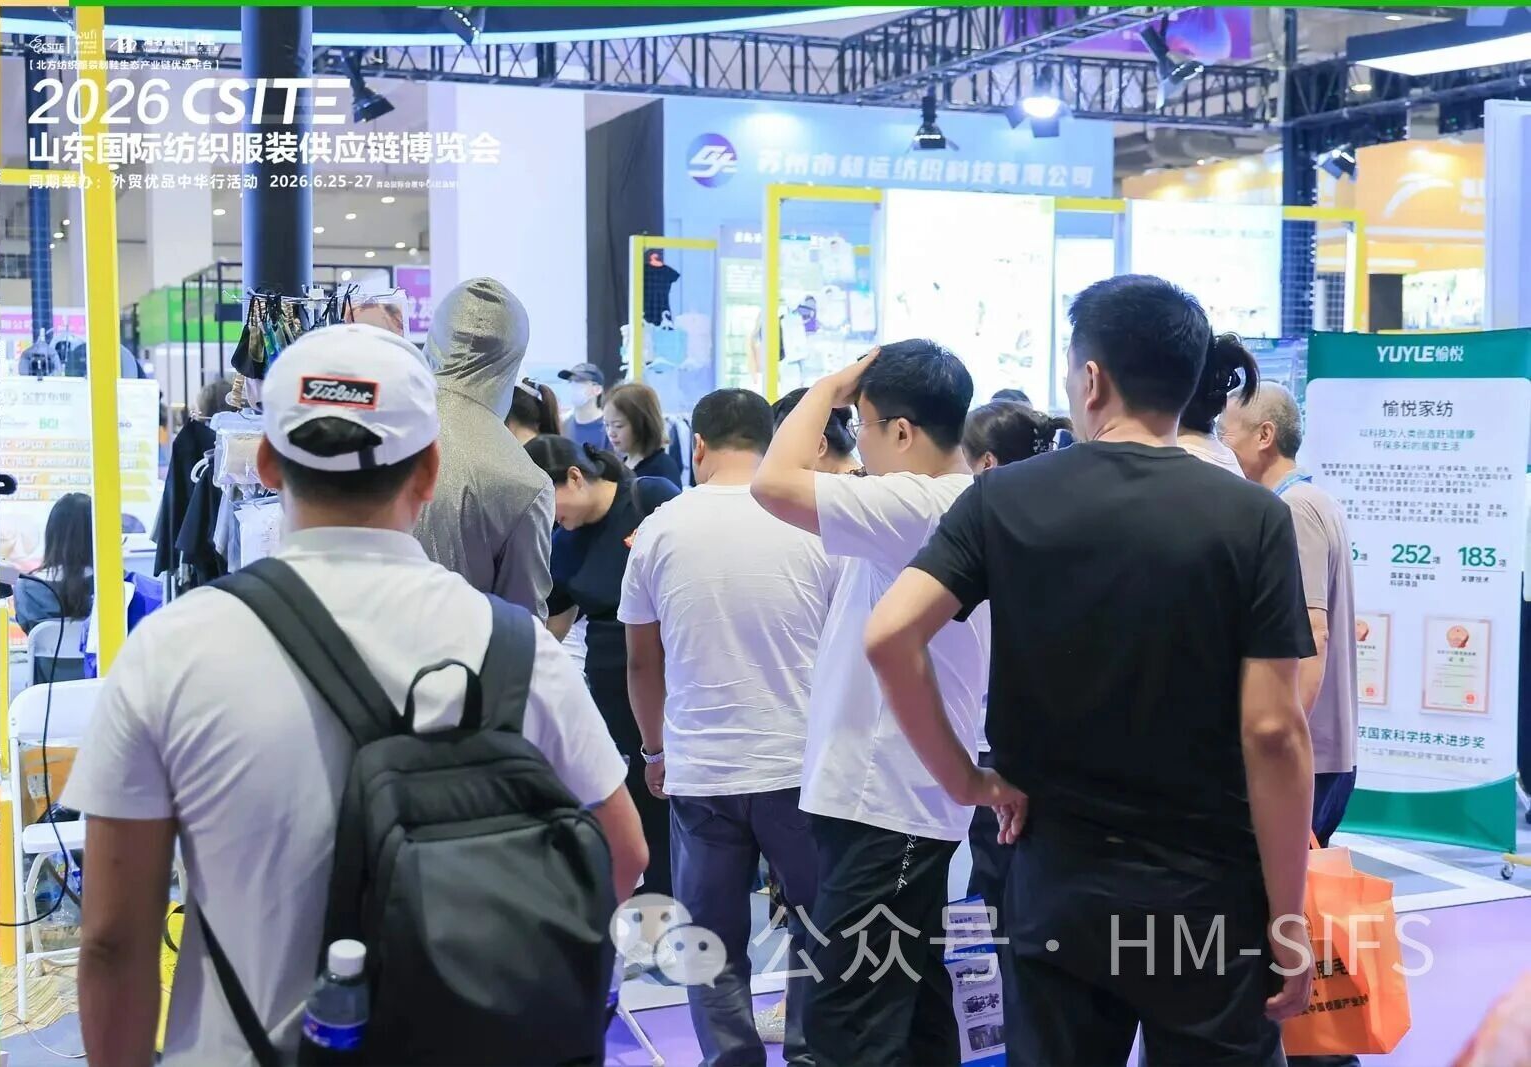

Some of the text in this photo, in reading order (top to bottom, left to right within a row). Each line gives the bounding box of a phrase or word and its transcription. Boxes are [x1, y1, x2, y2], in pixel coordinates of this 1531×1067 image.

[302, 380, 374, 404] Titleist
[1382, 400, 1454, 417] 愉悦家纺
[1391, 543, 1431, 565] 252
[1458, 546, 1497, 567] 183
